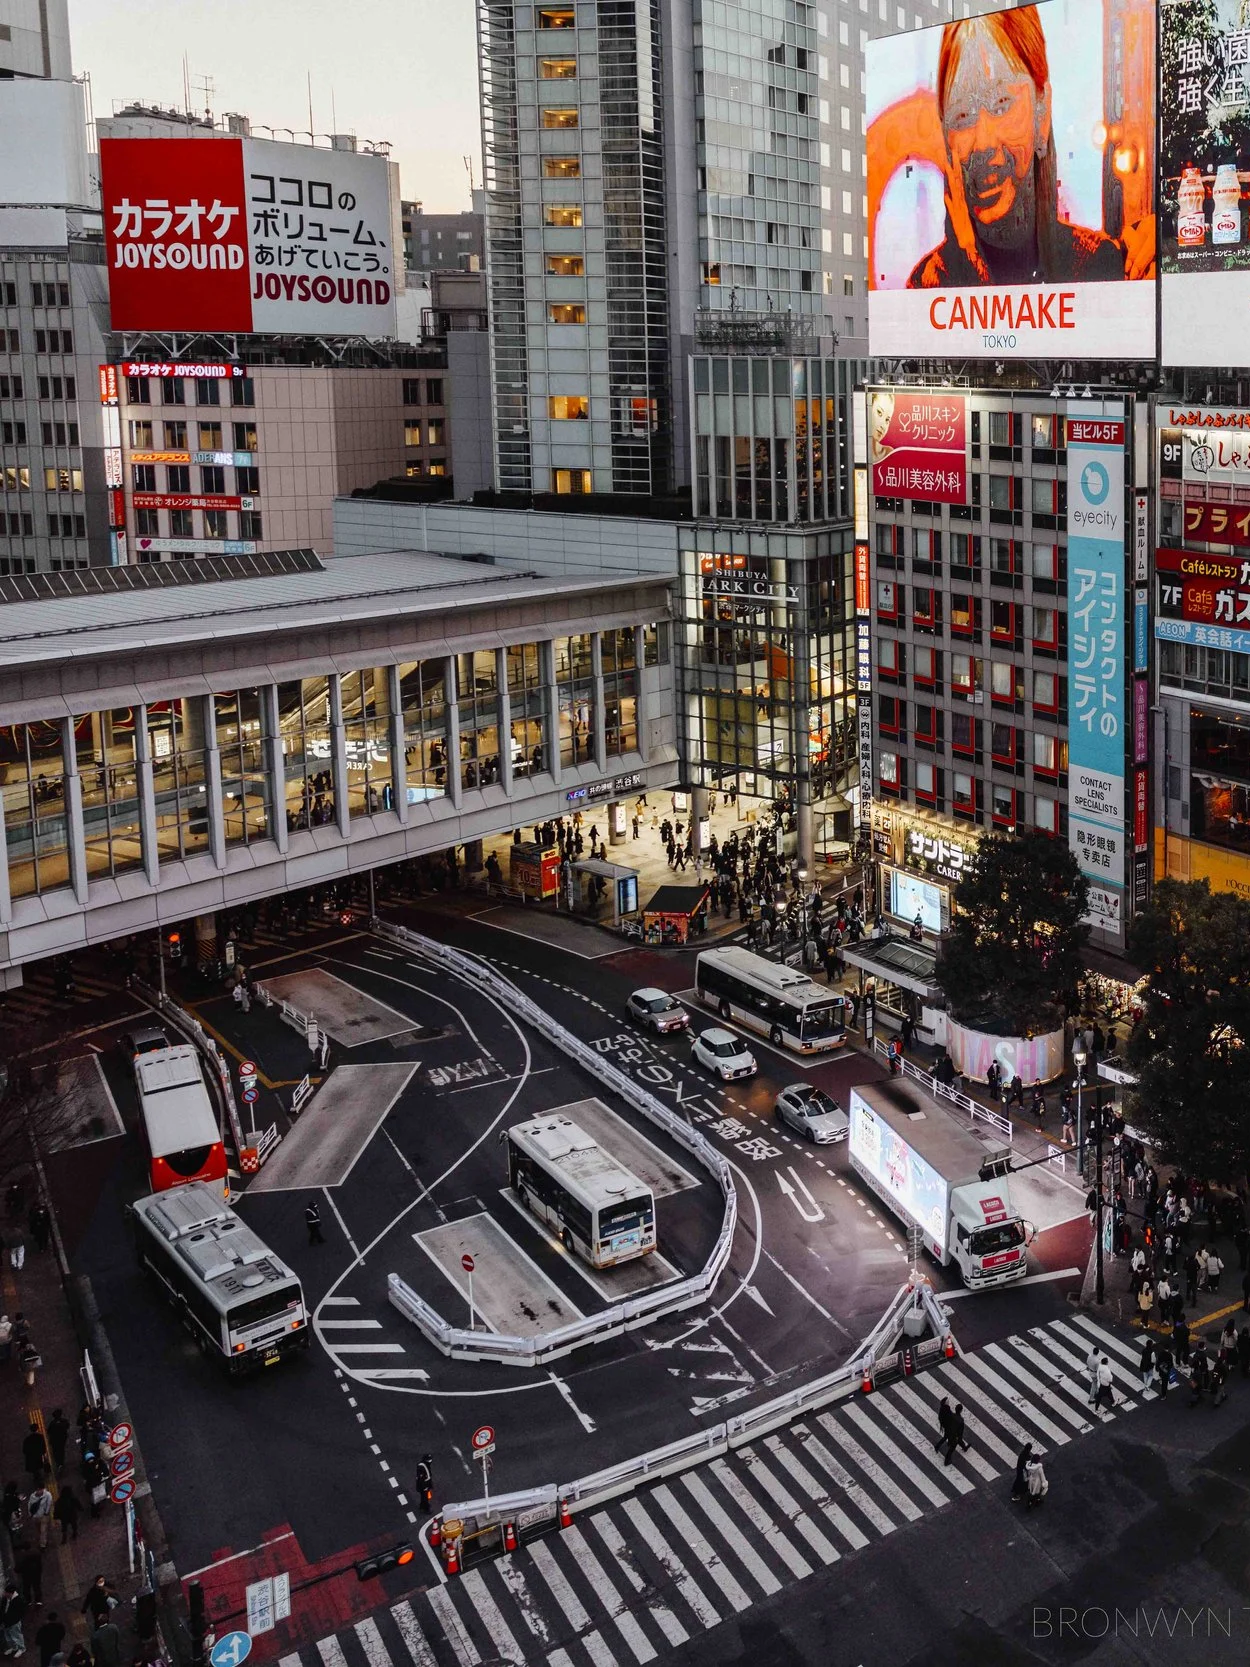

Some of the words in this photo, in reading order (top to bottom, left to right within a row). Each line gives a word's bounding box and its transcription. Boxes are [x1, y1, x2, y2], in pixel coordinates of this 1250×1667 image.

[250, 173, 356, 212] ココロの
[112, 198, 240, 240] カラオケ
[253, 209, 387, 249] ボリューム、
[114, 242, 244, 271] JOYSOUND
[254, 245, 390, 275] あげていこう。
[253, 272, 390, 306] JOYSOUND
[929, 293, 1075, 330] CANMAKE
[982, 335, 1017, 349] TOKYO
[129, 364, 172, 376] カラオケ
[174, 366, 226, 377] JOYSOUND
[233, 366, 244, 376] 9F
[911, 405, 961, 423] 品川スキン
[911, 424, 956, 443] クリニック
[1072, 423, 1119, 441] 当ビル5F
[193, 452, 234, 466] ADERANS
[1163, 444, 1181, 462] 9F
[886, 467, 961, 495] 品川美容外科
[242, 498, 252, 509] 6F
[1073, 509, 1118, 530] eyecity
[716, 568, 768, 580] SHIBUYA
[753, 582, 800, 597] CIY
[1162, 584, 1182, 602] 7F
[1188, 588, 1213, 604] Café
[1159, 622, 1186, 637] AEON
[1074, 568, 1097, 733] アイシティ
[1101, 572, 1118, 738] コンタクトの
[859, 698, 870, 707] 3F
[860, 721, 870, 740] 内科
[860, 742, 871, 779] 産婦人科
[1080, 775, 1112, 792] CONTACT
[861, 782, 872, 819] 心療内科
[1087, 788, 1105, 801] LENS
[1074, 796, 1118, 816] SPECIALISTS
[883, 819, 892, 832] 2F
[910, 830, 972, 872] サンドラ
[1077, 829, 1116, 854] 隐形眼镜
[1082, 847, 1111, 868] 专卖店
[590, 1034, 636, 1052] 6-22
[222, 1277, 244, 1295] 1911
